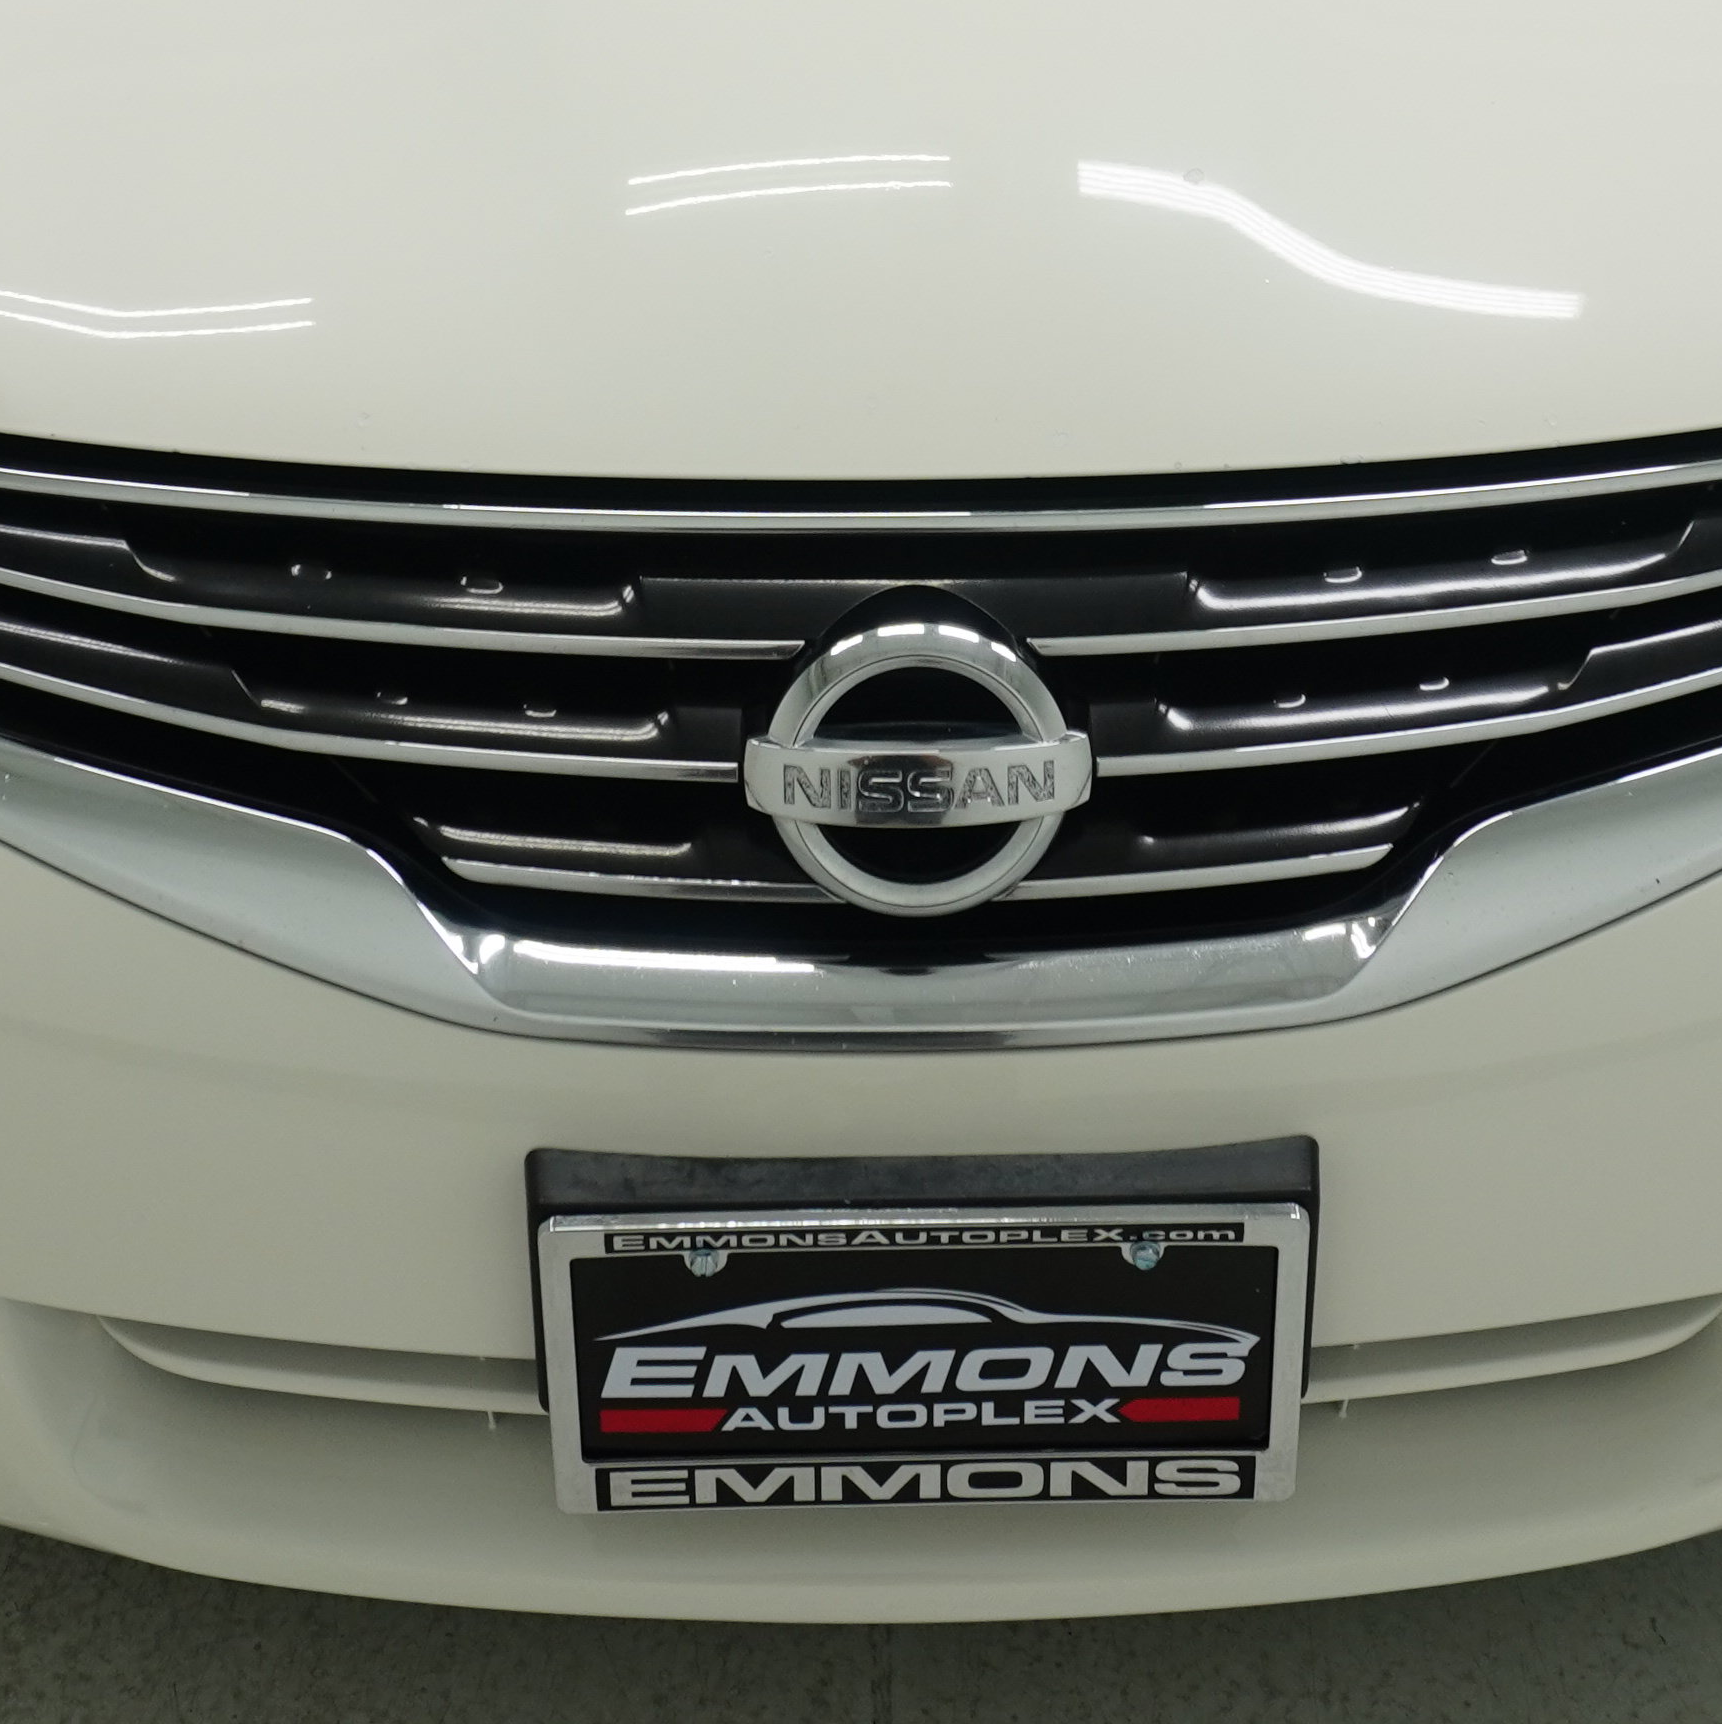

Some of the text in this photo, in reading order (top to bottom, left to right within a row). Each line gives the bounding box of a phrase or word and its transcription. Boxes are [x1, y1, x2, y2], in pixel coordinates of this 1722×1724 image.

[783, 760, 1055, 813] NISSAN
[600, 1341, 1247, 1400] EMMONS
[721, 1397, 1122, 1433] AUTOPLEX
[609, 1459, 1242, 1507] EMMONS
